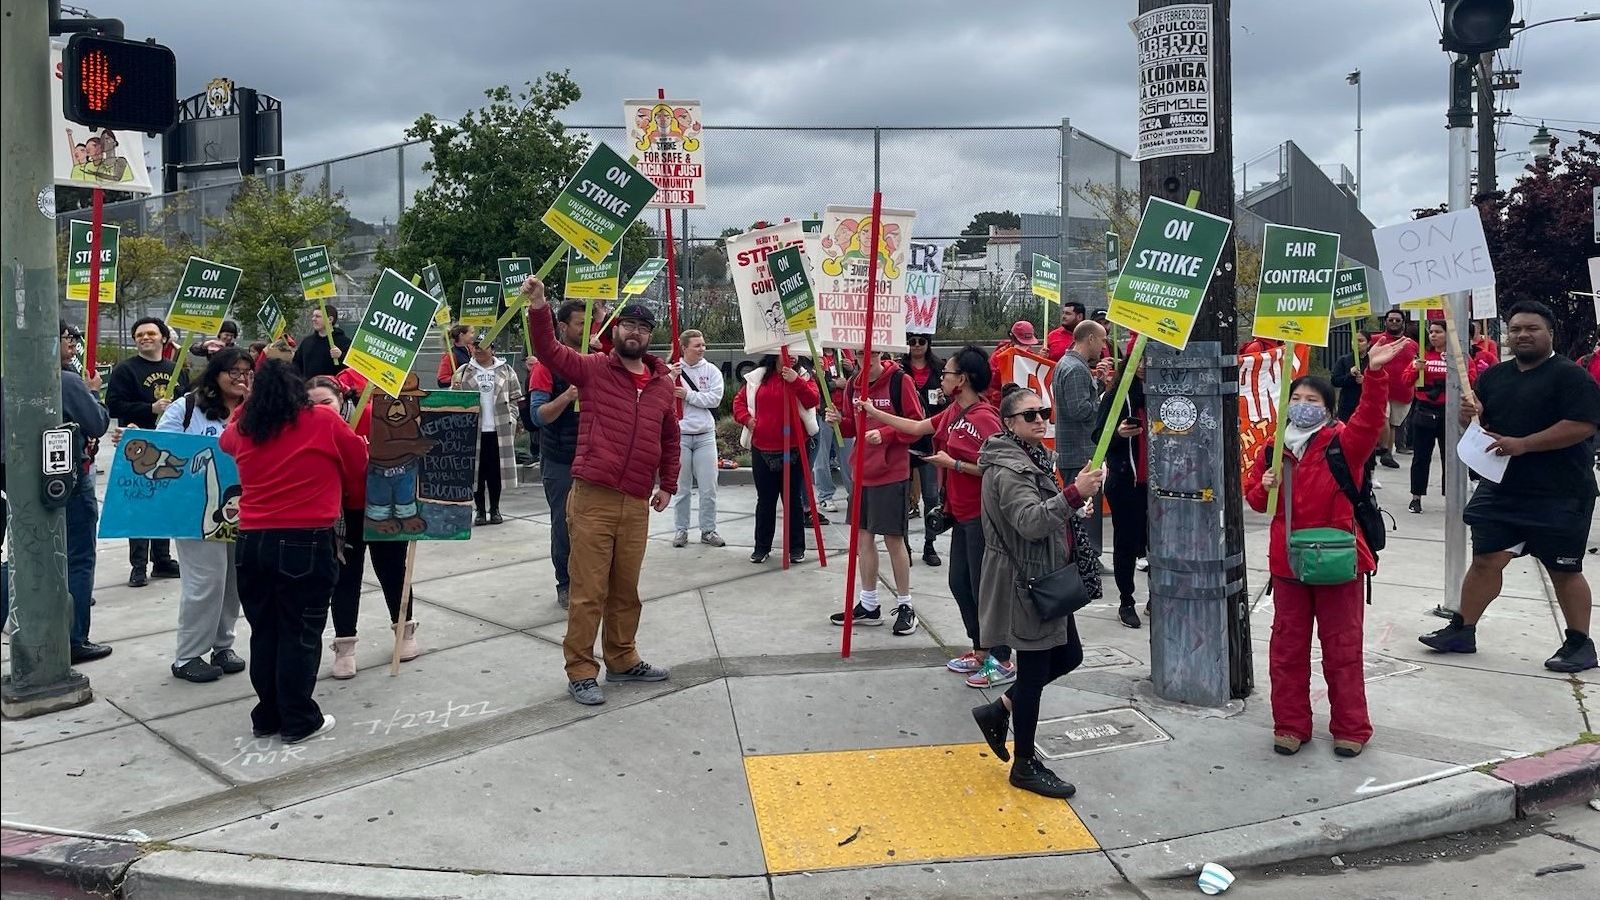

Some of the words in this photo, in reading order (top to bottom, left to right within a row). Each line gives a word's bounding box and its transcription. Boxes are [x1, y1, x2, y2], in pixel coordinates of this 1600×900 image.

[1164, 10, 1190, 22] FEBRERO
[1192, 10, 1207, 20] 2023
[1139, 21, 1195, 40] OCCAPULCO
[1140, 33, 1207, 55] LBERTO
[1150, 80, 1205, 97] CHOMBA
[1140, 99, 1207, 118] NSAMBLE
[1170, 113, 1206, 124] MÉXICO
[644, 152, 660, 162] FOR
[662, 152, 682, 163] SAFE
[686, 153, 691, 163] &
[606, 166, 631, 189] ON
[679, 165, 700, 177] JUST
[576, 180, 631, 218] STRIKE
[654, 190, 690, 203] CHOOLS
[568, 200, 593, 218] UNFAIR
[591, 212, 616, 231] LABOR
[569, 211, 604, 236] PRACTICES
[811, 225, 822, 235] ON
[1164, 219, 1194, 242] ON
[1399, 217, 1458, 252] ON
[1285, 242, 1316, 258] FAIR
[778, 255, 790, 272] ON
[908, 244, 941, 272] IR
[1041, 261, 1050, 269] ON
[1135, 250, 1203, 277] STRIKE
[202, 269, 220, 281] ON
[508, 263, 519, 275] ON
[575, 266, 594, 275] UNFAIR
[595, 264, 613, 273] LABOR
[581, 272, 608, 281] PRACTICES
[1035, 270, 1057, 281] STRIKE
[1264, 269, 1332, 284] CONTRACT
[1392, 246, 1488, 294] STRIKE
[780, 272, 804, 296] STRIKE
[1340, 273, 1352, 282] ON
[184, 286, 227, 300] STRIKE
[475, 286, 487, 294] ON
[1129, 280, 1159, 295] UNFAIR
[1160, 286, 1190, 299] LABOR
[1336, 283, 1363, 297] STRIKE
[181, 302, 200, 311] UNFAIR
[200, 304, 220, 313] LABOR
[391, 291, 415, 311] ON
[466, 297, 494, 305] STRIKE
[1134, 293, 1179, 308] PRACTICES
[1276, 298, 1315, 312] NOW!
[184, 309, 214, 317] PRACTICES
[370, 311, 419, 341] STRIKE
[364, 335, 387, 351] UNFAIR
[386, 344, 407, 358] LABOR
[366, 347, 399, 364] PRACTICES
[445, 431, 468, 441] ONLY
[438, 439, 461, 452] YOU
[423, 455, 477, 470] PROTECT
[118, 477, 171, 489] Oakland
[428, 471, 465, 481] PUBLIC
[421, 482, 476, 498] EDUCATION
